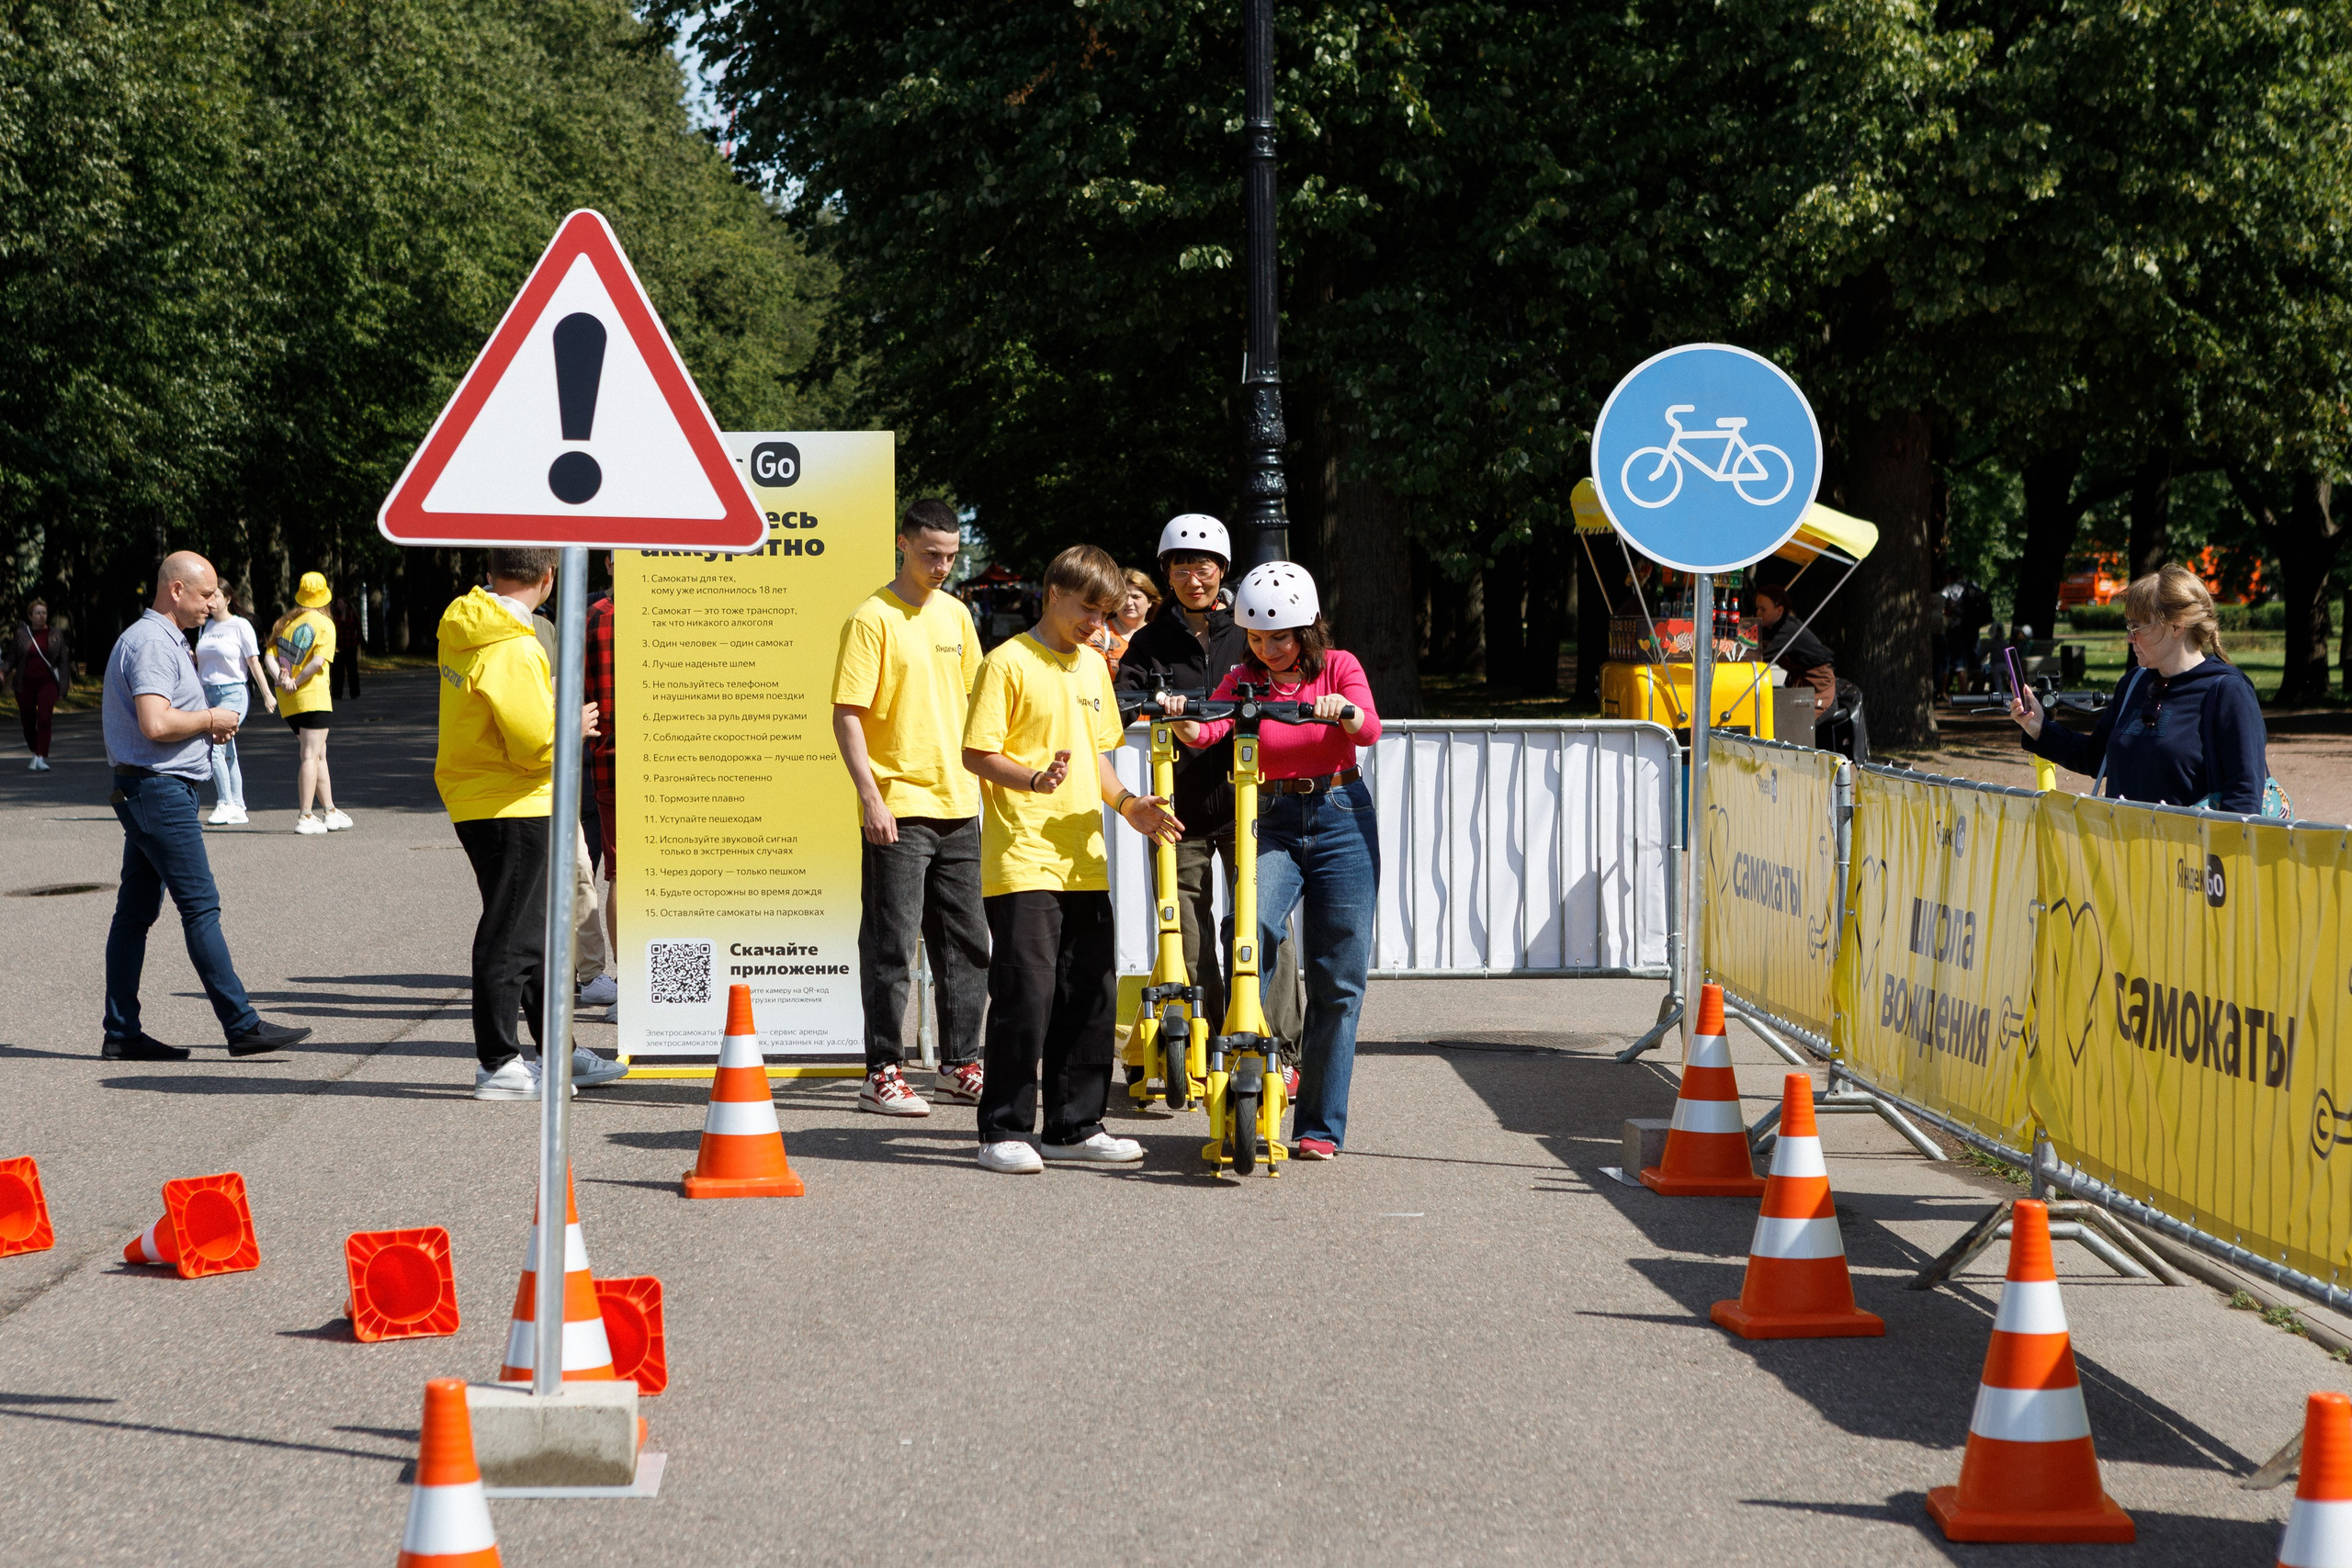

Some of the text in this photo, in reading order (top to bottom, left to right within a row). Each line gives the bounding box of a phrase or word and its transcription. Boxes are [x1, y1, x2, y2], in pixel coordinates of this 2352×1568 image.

[756, 450, 797, 479] Go
[642, 573, 736, 584] 1. Самокаты для тех,
[651, 588, 674, 597] кому
[676, 587, 695, 596] уже
[696, 587, 757, 595] исполнилось
[759, 585, 770, 594] 18
[642, 606, 650, 615] 2.
[651, 606, 691, 615] Самокат
[705, 607, 719, 615] это
[721, 607, 744, 615] тоже
[746, 607, 797, 616] транспорт,
[686, 619, 729, 627] никакого
[731, 619, 773, 627] алкоголя
[642, 638, 650, 649] 3.
[652, 638, 677, 649] Один
[730, 640, 753, 649] один
[755, 639, 793, 648] самокат
[642, 660, 650, 669] 4.
[652, 659, 683, 671] Лучше
[685, 660, 728, 670] наденьте
[643, 680, 778, 691] 5. Не пользуйтесь телефоном
[661, 693, 719, 703] наушниками
[722, 693, 733, 701] во
[735, 693, 763, 702] время
[766, 693, 804, 702] поездки
[643, 712, 650, 722] 6.
[653, 712, 705, 723] Держитесь
[718, 714, 740, 723] руль
[741, 713, 770, 723] двумя
[773, 713, 807, 722] руками
[643, 732, 801, 743] 7. Соблюдайте скоростной режим
[643, 753, 650, 762] 8.
[653, 753, 675, 762] Если
[677, 754, 697, 762] есть
[699, 754, 762, 763] велодорожка
[775, 754, 804, 763] лучше
[820, 752, 837, 761] ней
[643, 773, 773, 783] 9. Разгоняйтесь постепенно
[644, 794, 657, 804] 10.
[660, 794, 709, 805] Тормозите
[644, 815, 762, 826] 11. Уступайте пешеходам
[644, 834, 797, 846] 12. Используйте звуковой сигнал
[661, 848, 793, 857] только в экстренных случаях
[645, 867, 657, 877] 13.
[660, 867, 688, 878] Через
[690, 868, 723, 878] дорогу
[737, 868, 767, 876] только
[1733, 851, 1802, 919] самокаты
[645, 887, 822, 898] 14. Будьте осторожны во время дождя
[645, 908, 658, 918] 15.
[661, 908, 715, 918] Оставляйте
[776, 908, 824, 918] парковках
[1909, 897, 1976, 972] школа
[730, 942, 818, 957] Скачайте
[730, 964, 849, 978] приложение
[803, 987, 829, 995] QR-код
[1881, 972, 1991, 1068] вождения
[647, 1029, 716, 1038] Электросамокаты
[770, 1029, 797, 1037] сервис
[799, 1029, 828, 1037] аренды
[2114, 971, 2296, 1094] самокаты
[647, 1040, 718, 1048] электросамокатов
[771, 1040, 811, 1048] указанных
